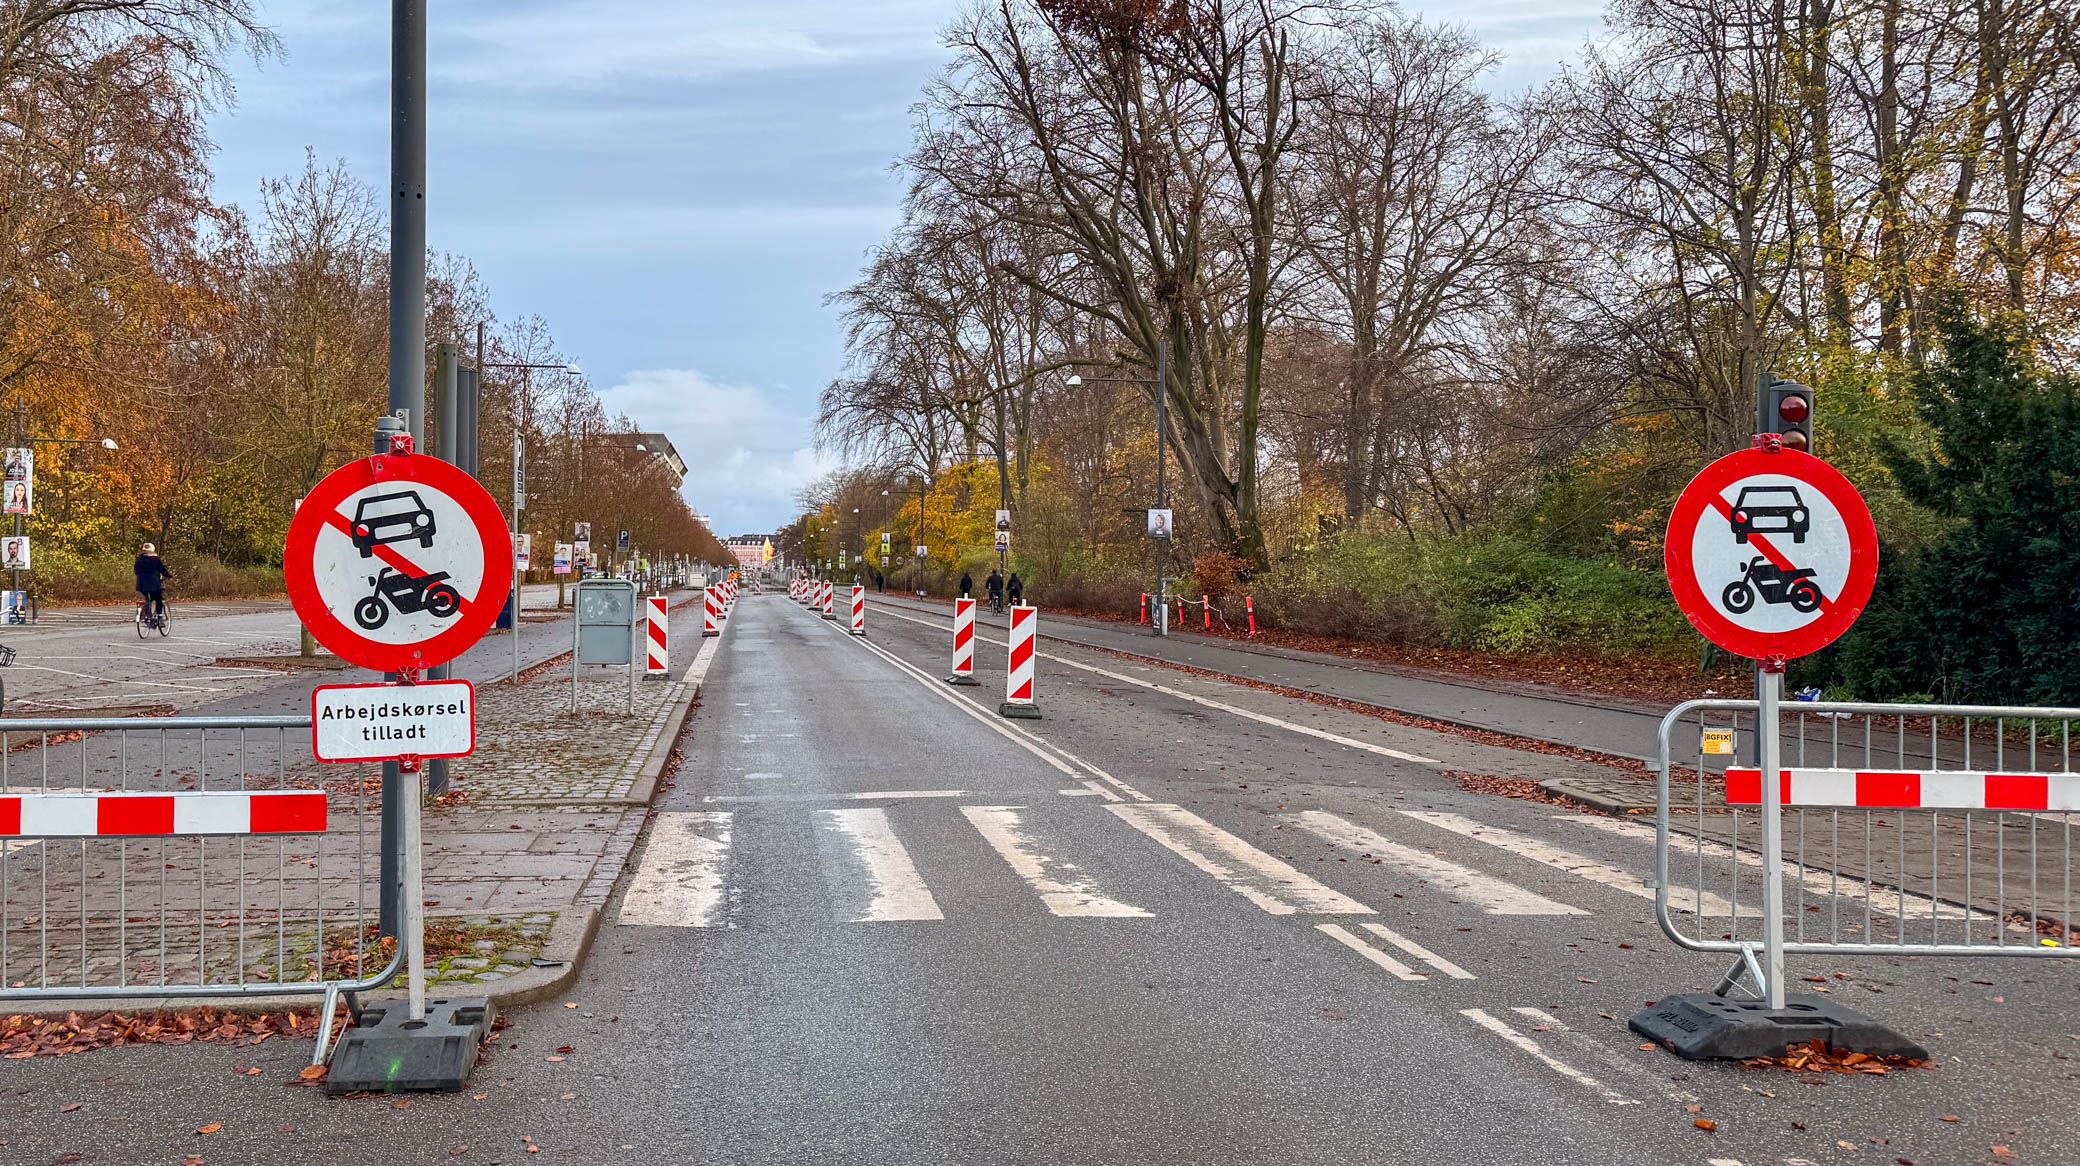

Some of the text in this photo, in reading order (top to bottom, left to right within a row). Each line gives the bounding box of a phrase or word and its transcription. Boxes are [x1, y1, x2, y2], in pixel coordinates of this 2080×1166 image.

[621, 530, 627, 540] P
[321, 700, 466, 721] Arbejdskørsel
[362, 724, 426, 741] tilladt
